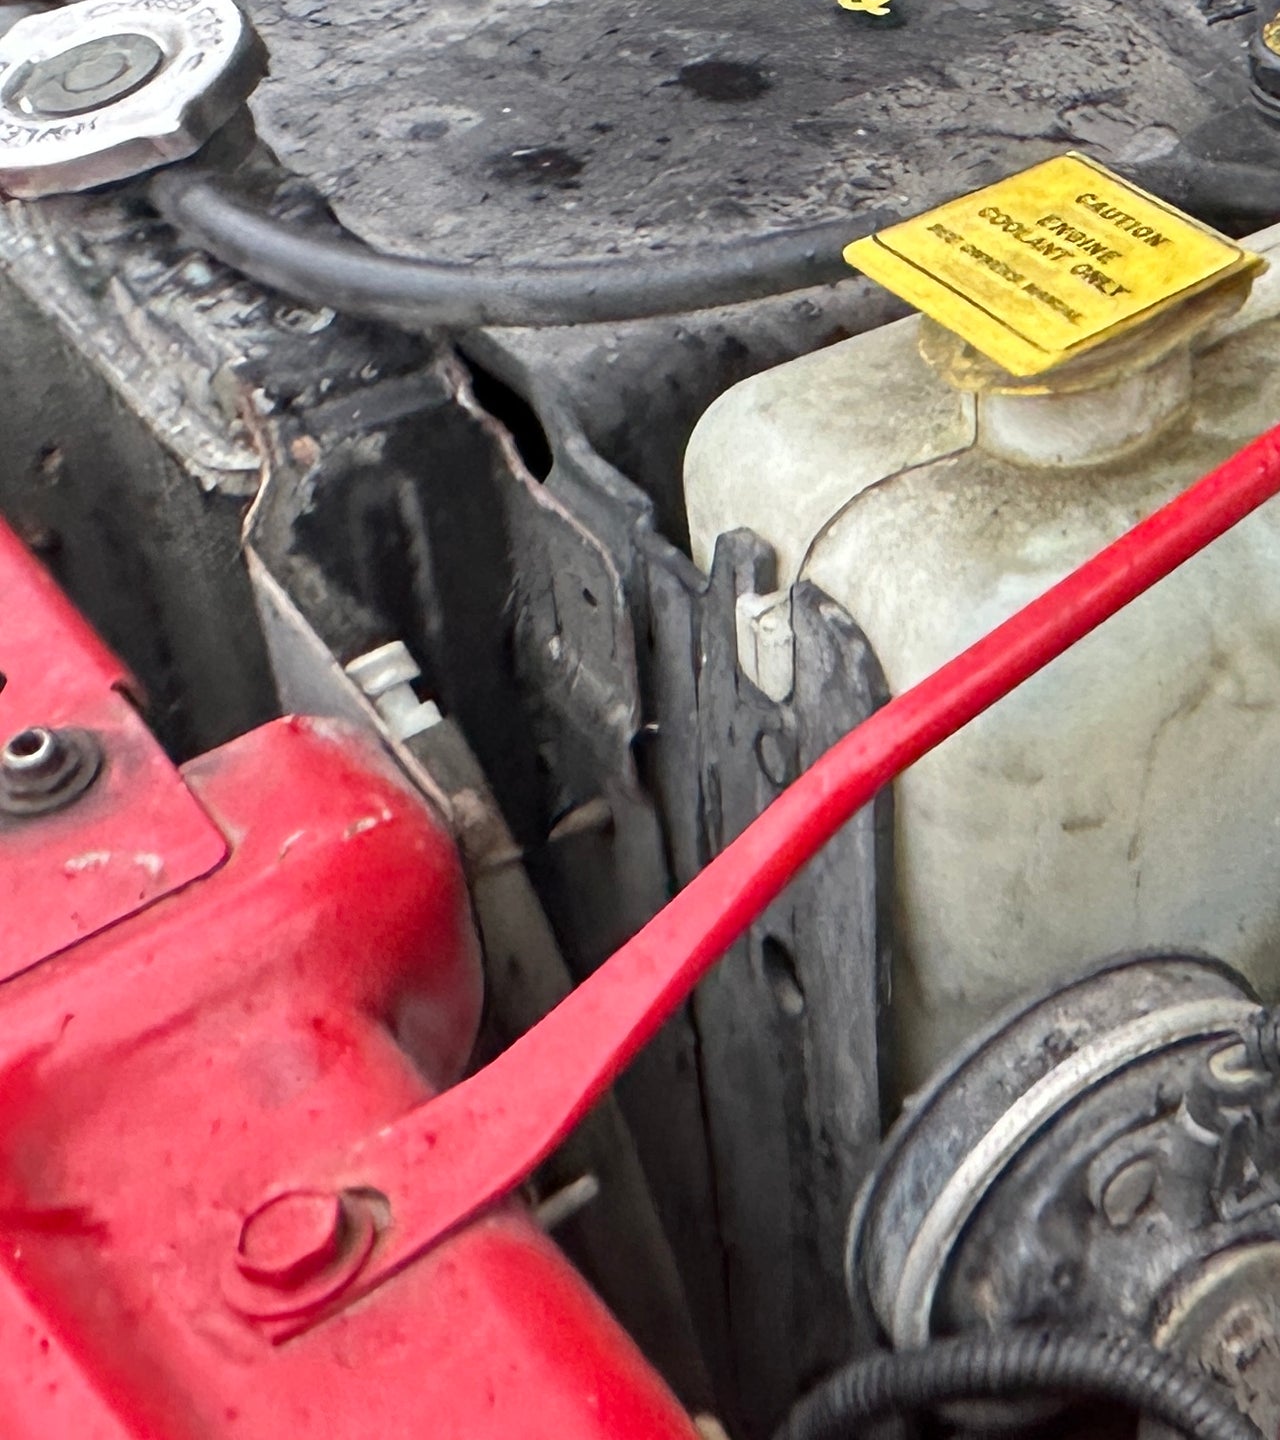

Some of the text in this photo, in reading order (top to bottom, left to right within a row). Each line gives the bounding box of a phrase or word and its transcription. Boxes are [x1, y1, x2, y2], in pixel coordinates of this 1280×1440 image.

[1036, 213, 1122, 266] ENGINE
[1075, 192, 1170, 248] CAUTION
[978, 206, 1076, 263] COOLANT
[1069, 262, 1130, 298] ONLY
